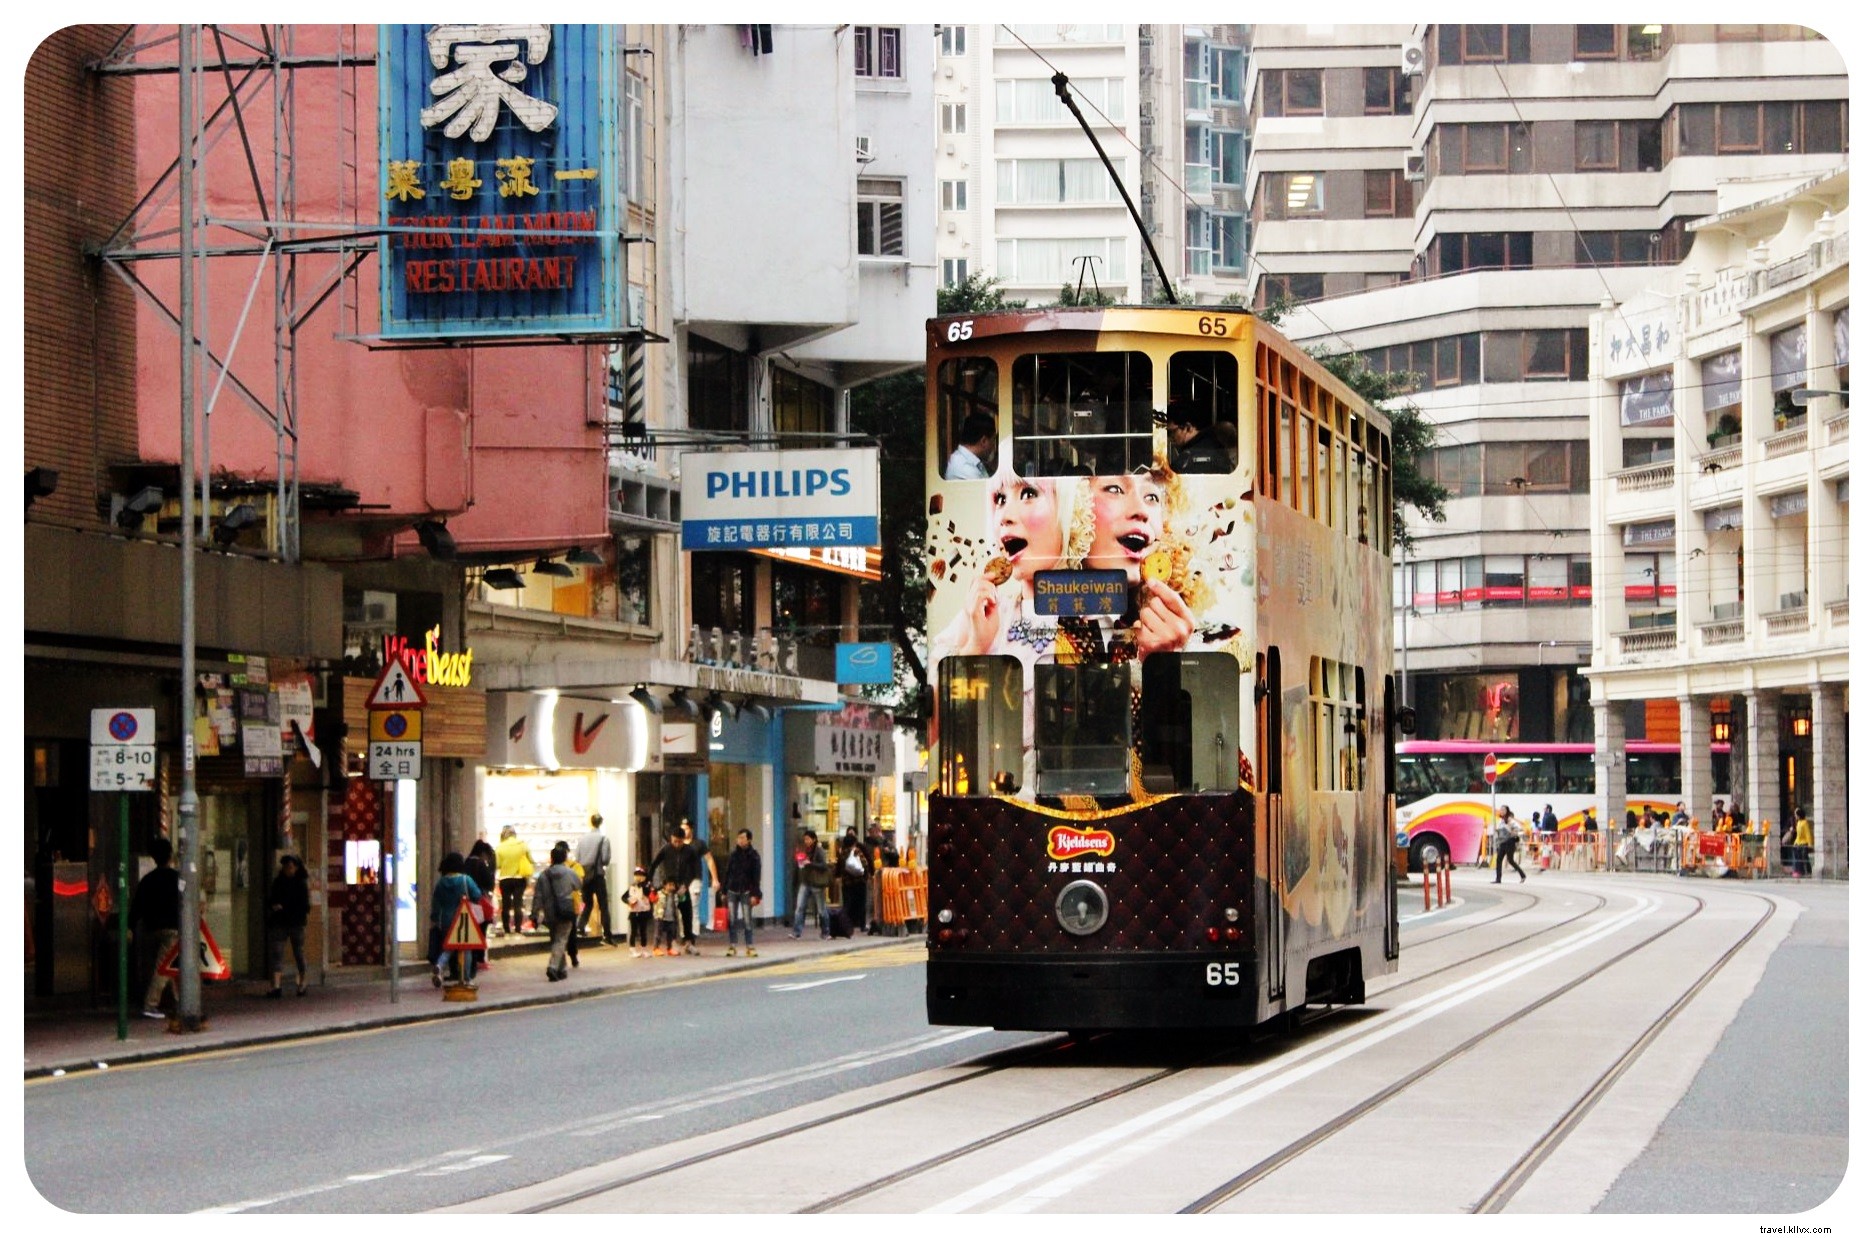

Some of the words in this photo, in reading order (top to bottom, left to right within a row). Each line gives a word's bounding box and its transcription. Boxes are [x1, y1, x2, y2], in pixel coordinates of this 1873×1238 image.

[461, 213, 515, 249] LAM
[523, 209, 597, 246] MOON
[406, 256, 578, 294] RESTAURANT
[948, 320, 974, 342] 65
[1199, 316, 1227, 336] 65
[1639, 407, 1651, 421] THE
[707, 468, 851, 499] PHILIPS
[1641, 530, 1652, 542] THE
[1037, 580, 1123, 594] Shaukeiwan
[116, 751, 152, 765] 8-10
[375, 746, 392, 757] 24
[395, 745, 415, 757] hrs
[379, 761, 410, 775] 全日
[1056, 832, 1108, 853] Kjeldsens
[1206, 962, 1240, 986] 65
